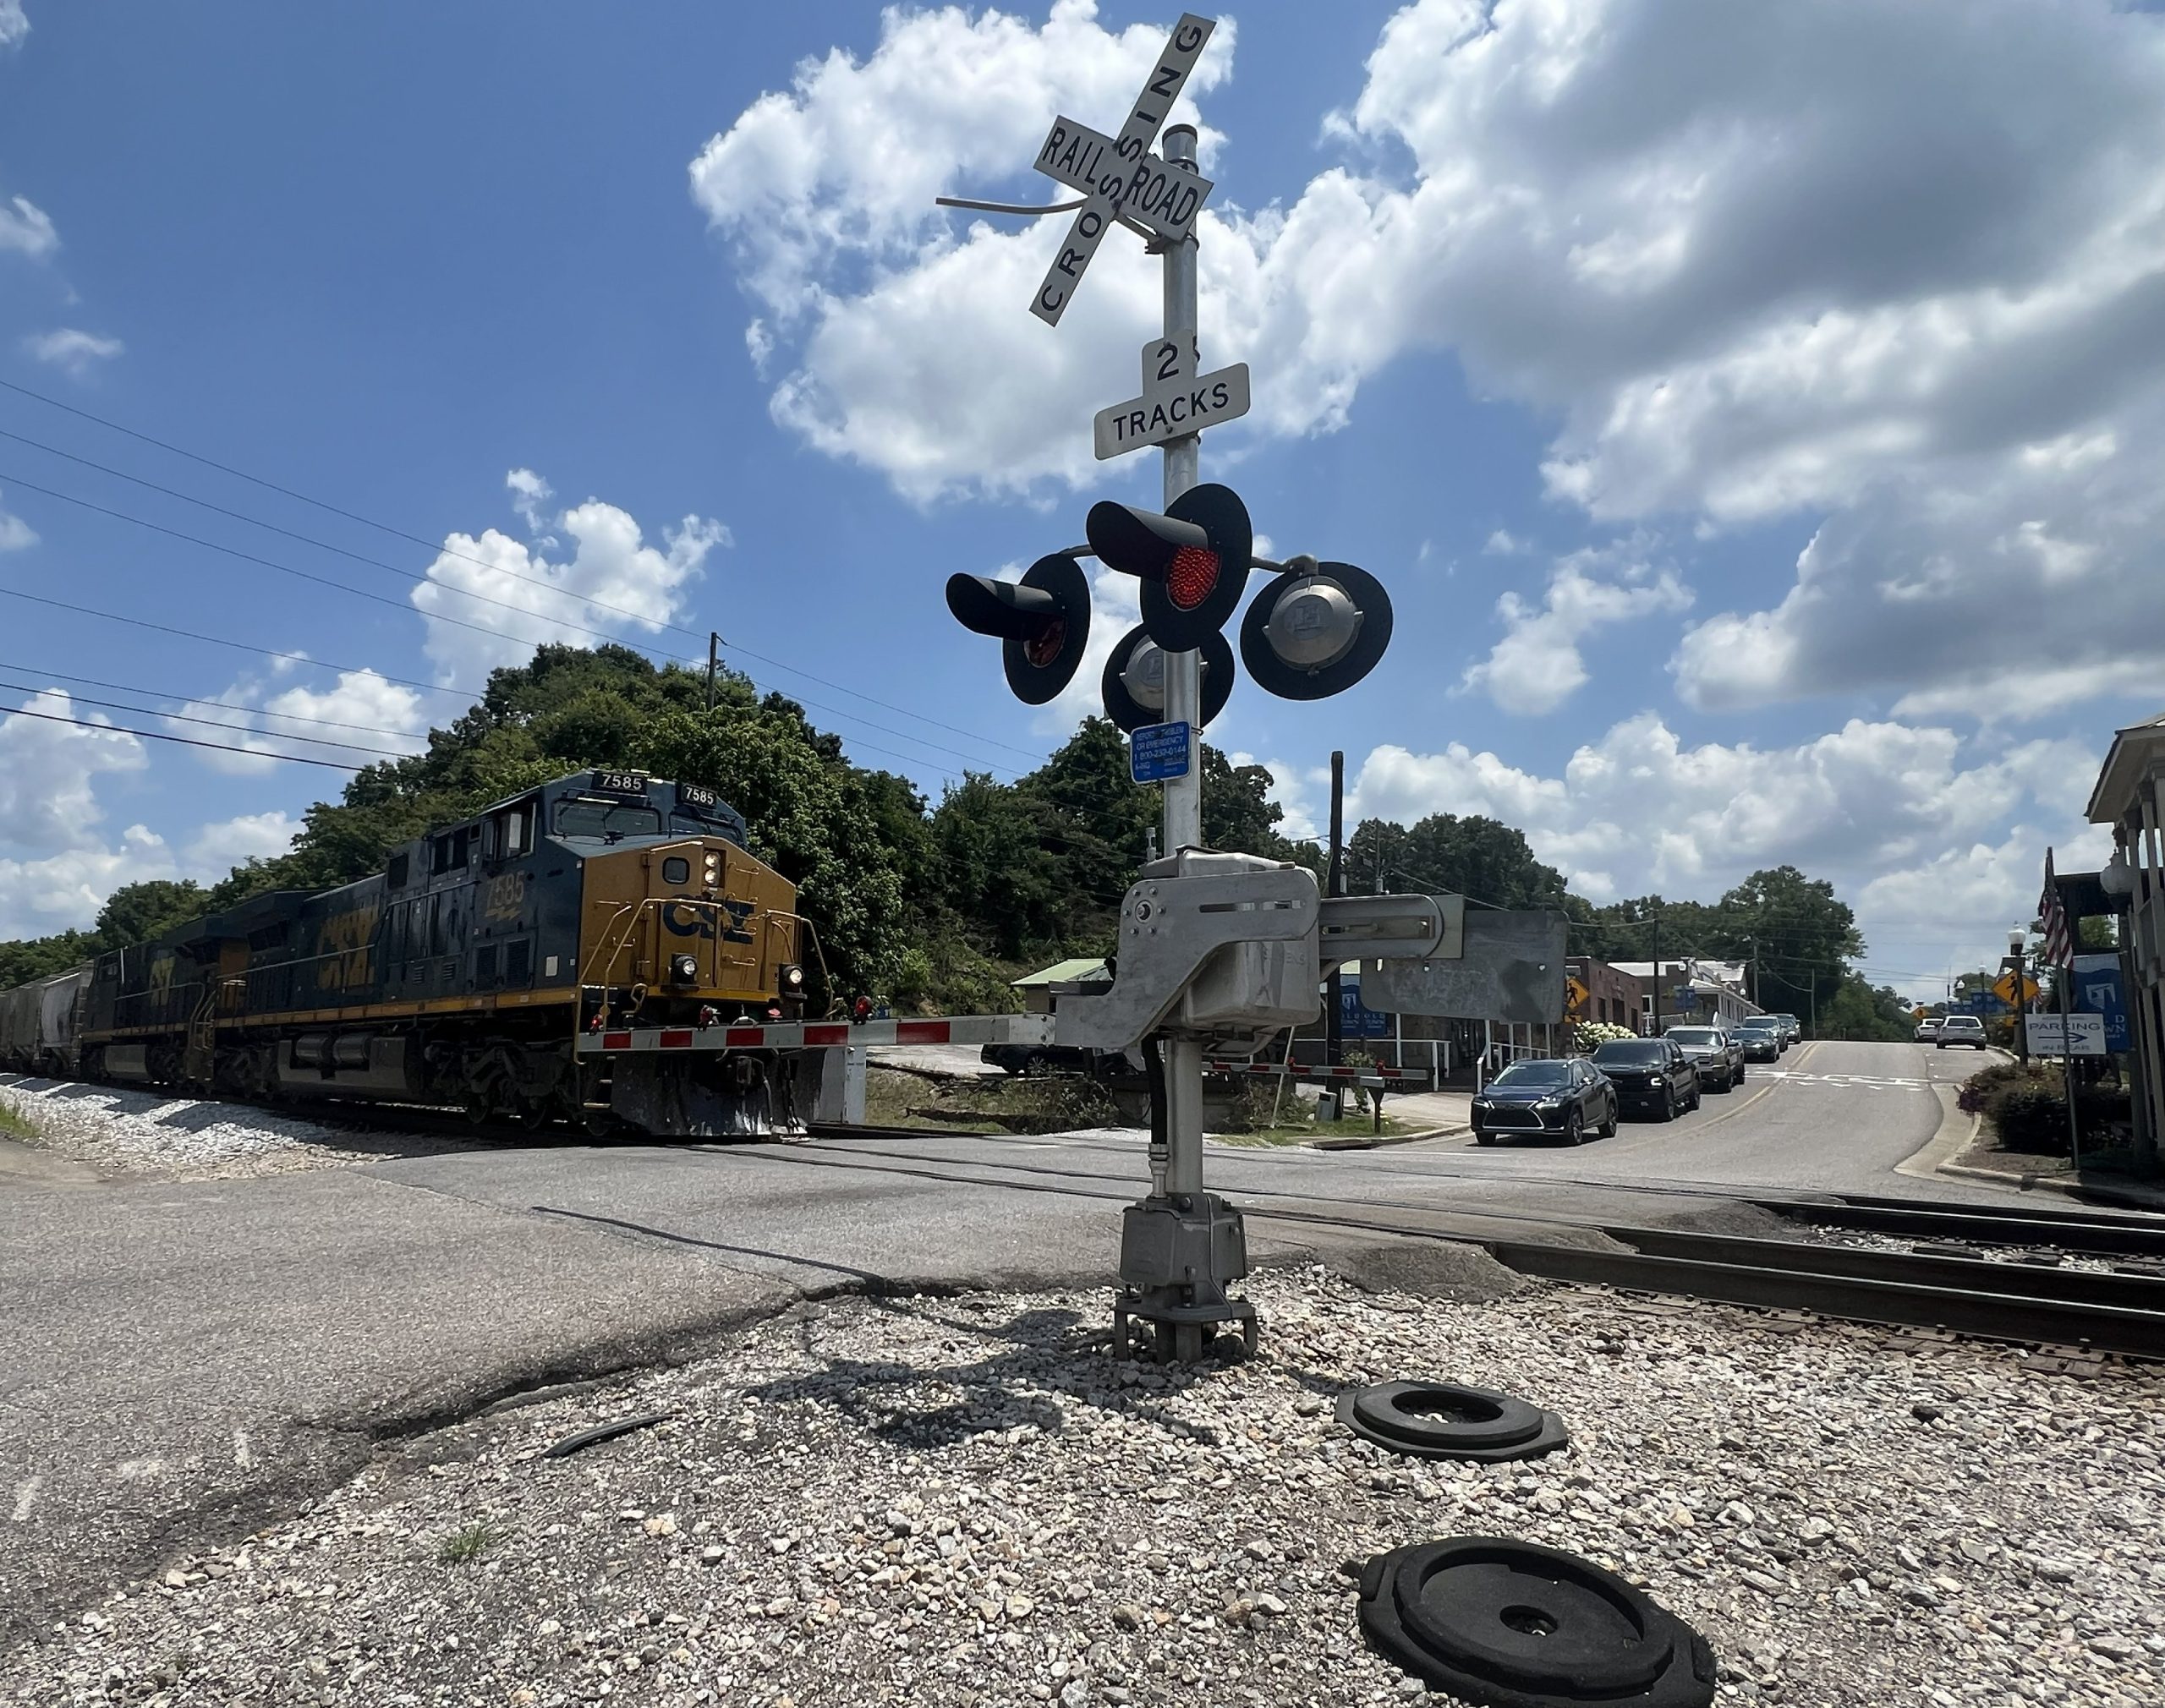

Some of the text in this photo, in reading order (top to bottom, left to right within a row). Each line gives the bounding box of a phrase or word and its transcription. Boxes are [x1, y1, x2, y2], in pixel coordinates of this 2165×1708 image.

[1040, 25, 1203, 312] CROSSING
[1156, 344, 1180, 381] 2
[1113, 382, 1230, 441] TRACKS
[602, 774, 642, 791] 7585
[685, 786, 714, 805] 7585
[487, 870, 525, 910] 7585
[2104, 1023, 2125, 1032] WN
